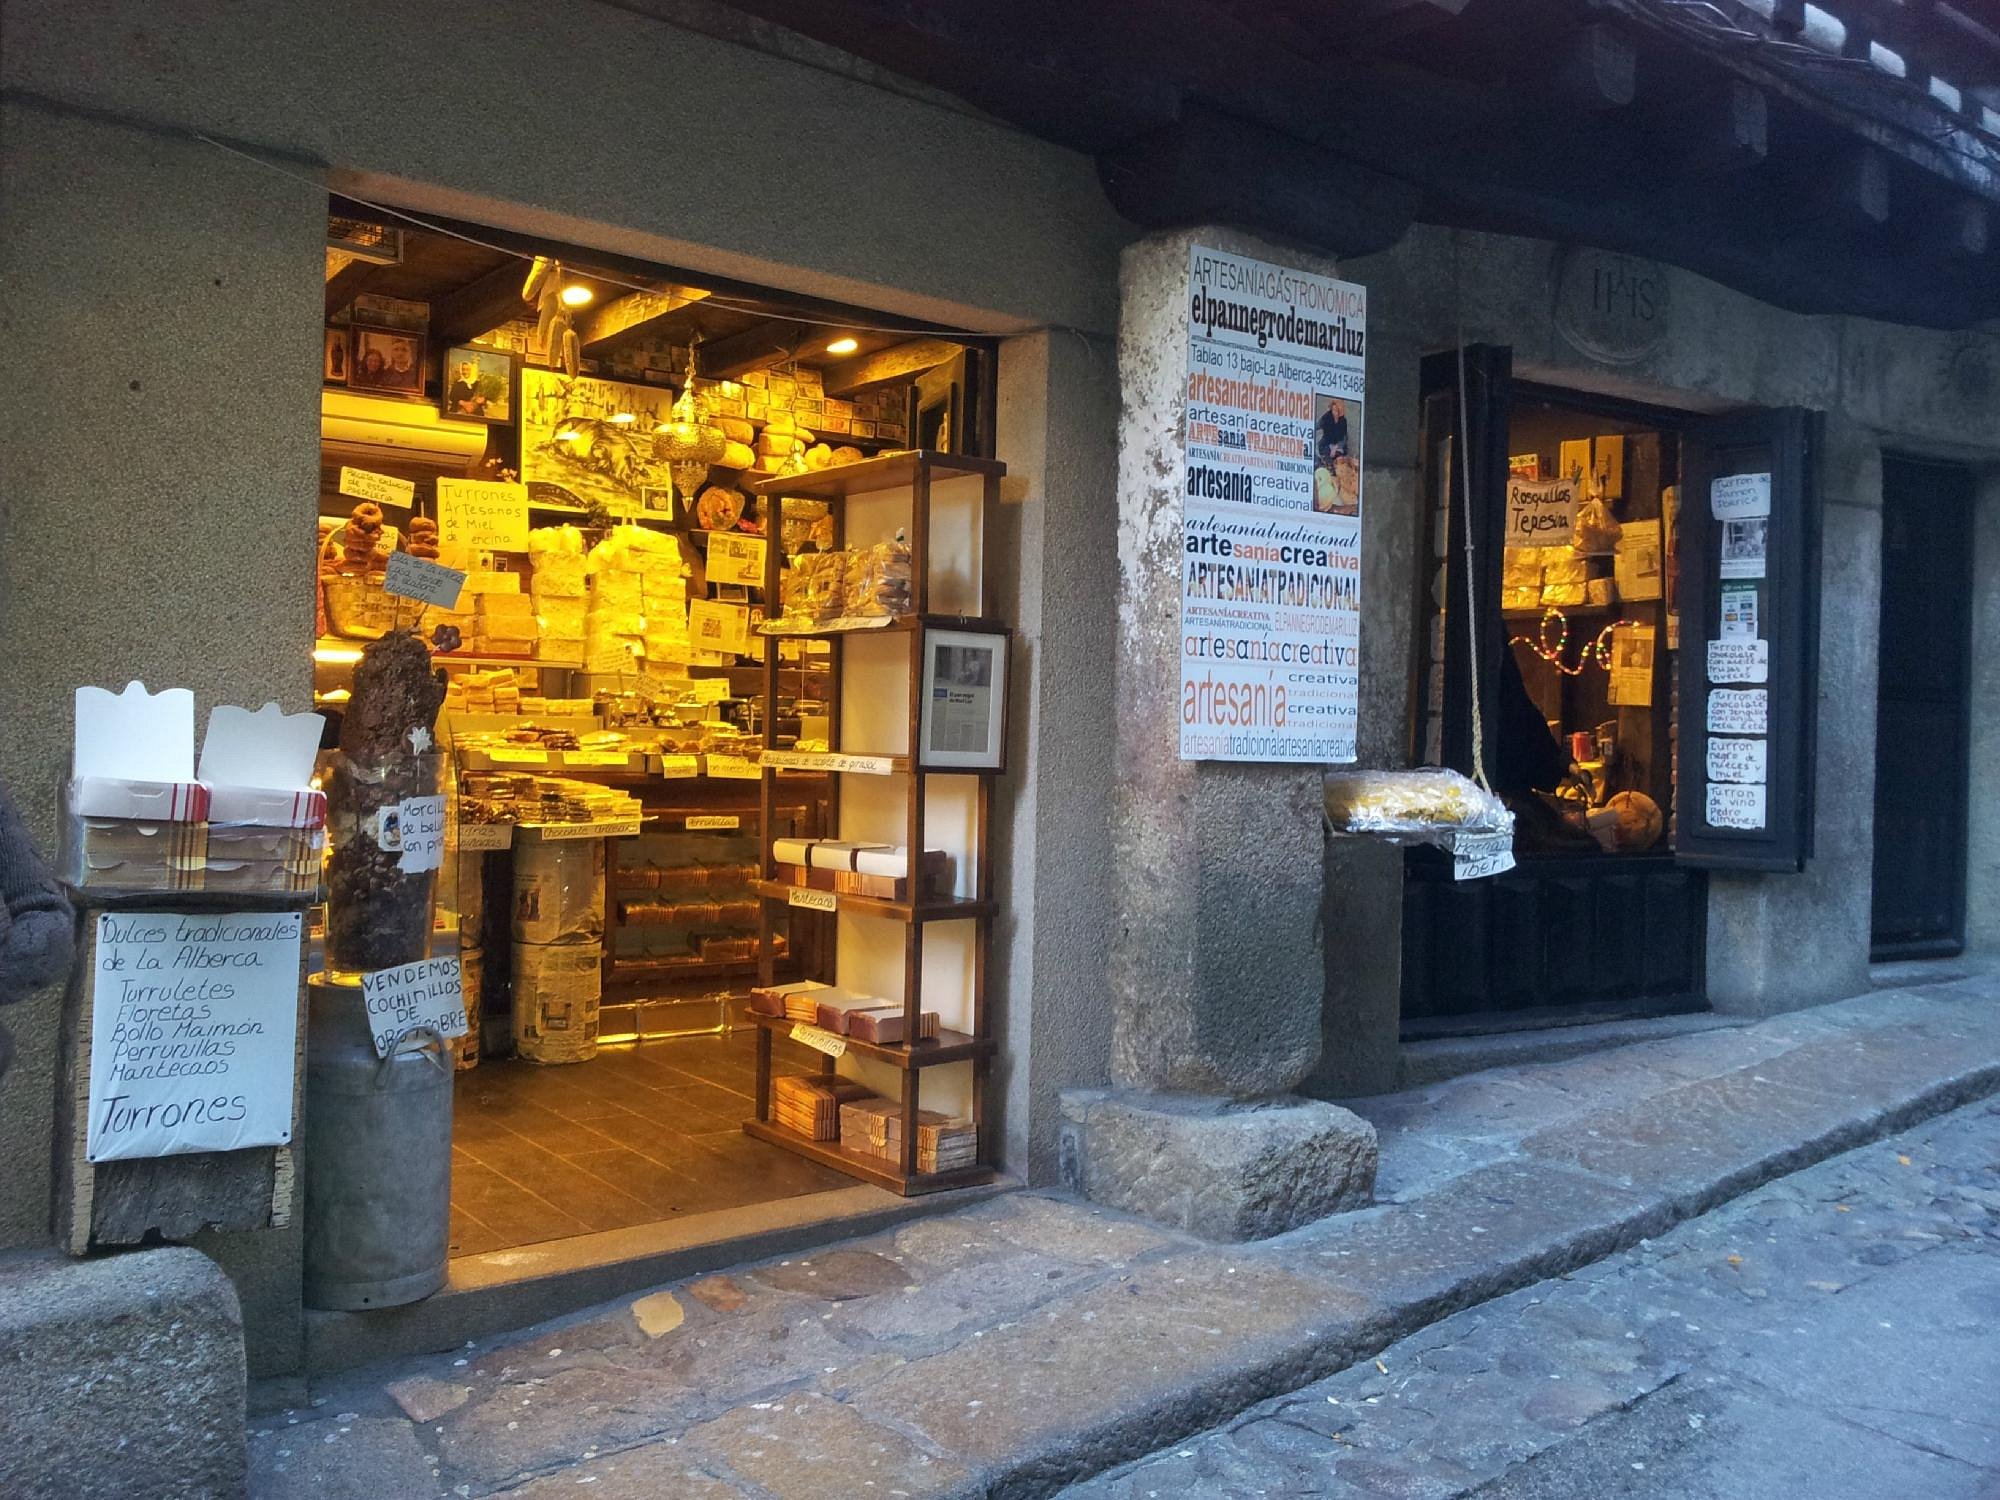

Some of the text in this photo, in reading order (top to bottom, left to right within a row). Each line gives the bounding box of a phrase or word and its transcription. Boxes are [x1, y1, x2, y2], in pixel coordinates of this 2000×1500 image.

[1192, 285, 1364, 357] elpannegrodemariluz
[1191, 343, 1223, 367] Tablao
[1227, 351, 1238, 369] 13
[1253, 493, 1313, 512] tradicional
[1185, 631, 1357, 667] artesaníacreativa
[1183, 669, 1358, 728] artesanía creativa
[1288, 688, 1358, 700] tradicional
[1288, 703, 1357, 716] creativa
[1288, 718, 1357, 730] tradicional
[401, 821, 415, 836] de
[403, 839, 421, 853] con
[102, 917, 299, 943] Dulces tradicionales
[103, 948, 127, 971] de
[172, 945, 263, 969] Alberca
[363, 959, 460, 992] VENDEMOS
[121, 976, 235, 1004] Turruletes
[116, 1003, 212, 1024] Floretas
[396, 1005, 420, 1023] DE
[110, 1021, 164, 1044] Bollo
[112, 1038, 236, 1064] Perrunillas
[109, 1057, 230, 1082] Mantecaos
[101, 1093, 248, 1136] Turrones
